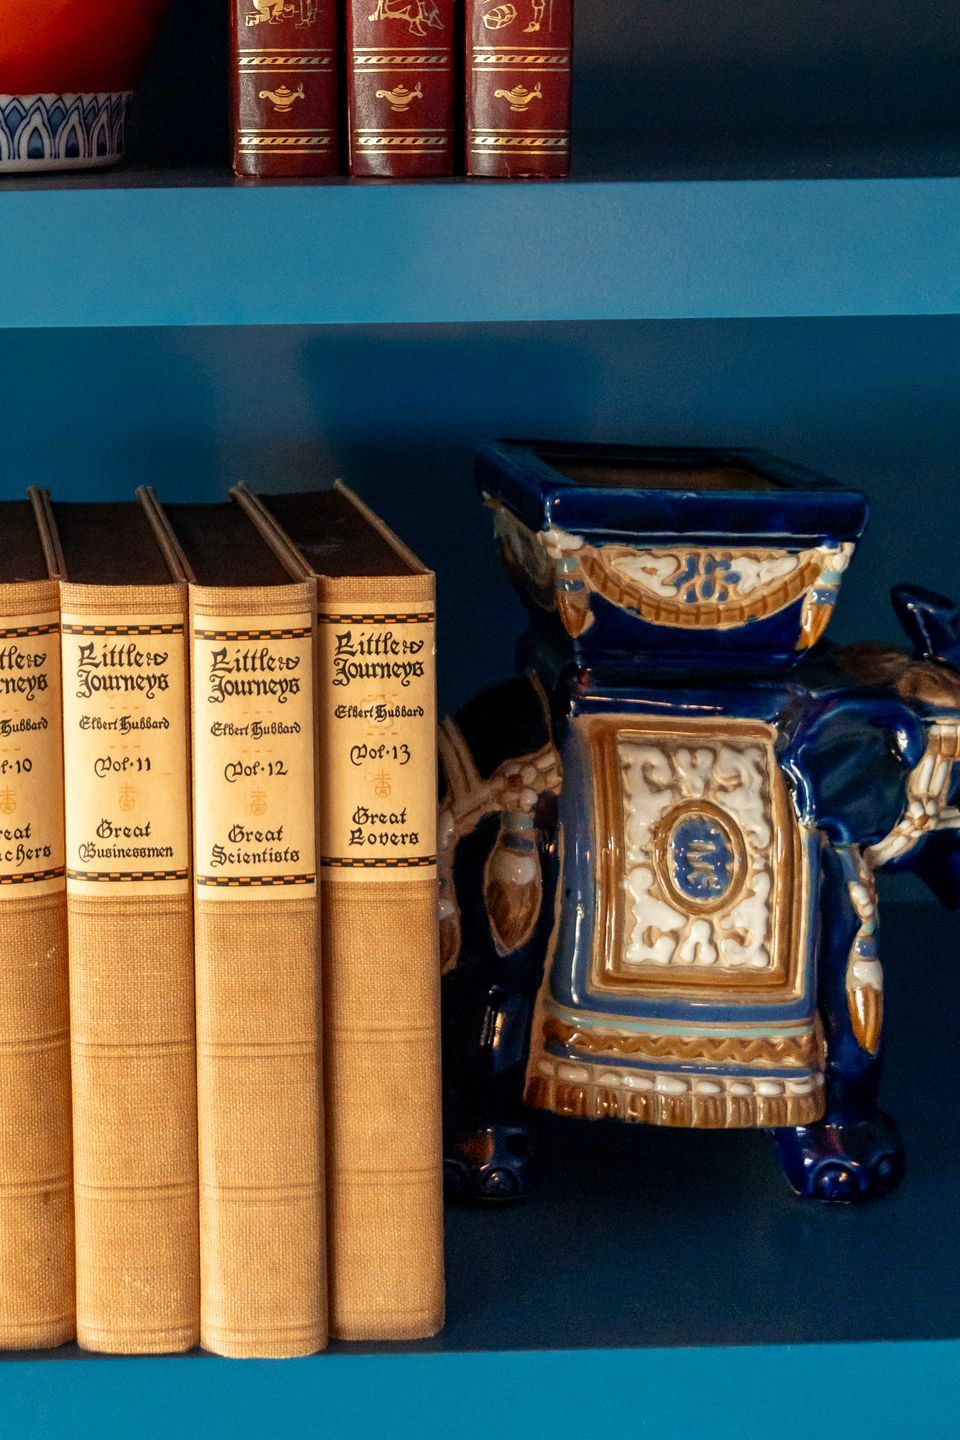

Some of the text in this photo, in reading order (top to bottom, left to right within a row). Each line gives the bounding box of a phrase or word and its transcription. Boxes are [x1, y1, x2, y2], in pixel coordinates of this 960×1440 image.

[334, 630, 400, 657] Little
[78, 642, 144, 668] Little
[210, 647, 276, 673] Little
[332, 658, 424, 686] Journeys
[76, 670, 169, 699] Journeys
[208, 674, 300, 703] Journeys
[334, 704, 424, 722] Elbert Hubbard
[0, 716, 48, 736] Hubbard
[79, 715, 170, 735] Elbert Hubbard
[210, 720, 301, 739] Elbert Hubbard
[352, 806, 407, 825] Great
[96, 818, 151, 838] Great
[228, 824, 283, 843] Great
[349, 827, 419, 846] Lovers
[78, 841, 173, 862] Businessmen
[210, 843, 300, 867] Scientists
